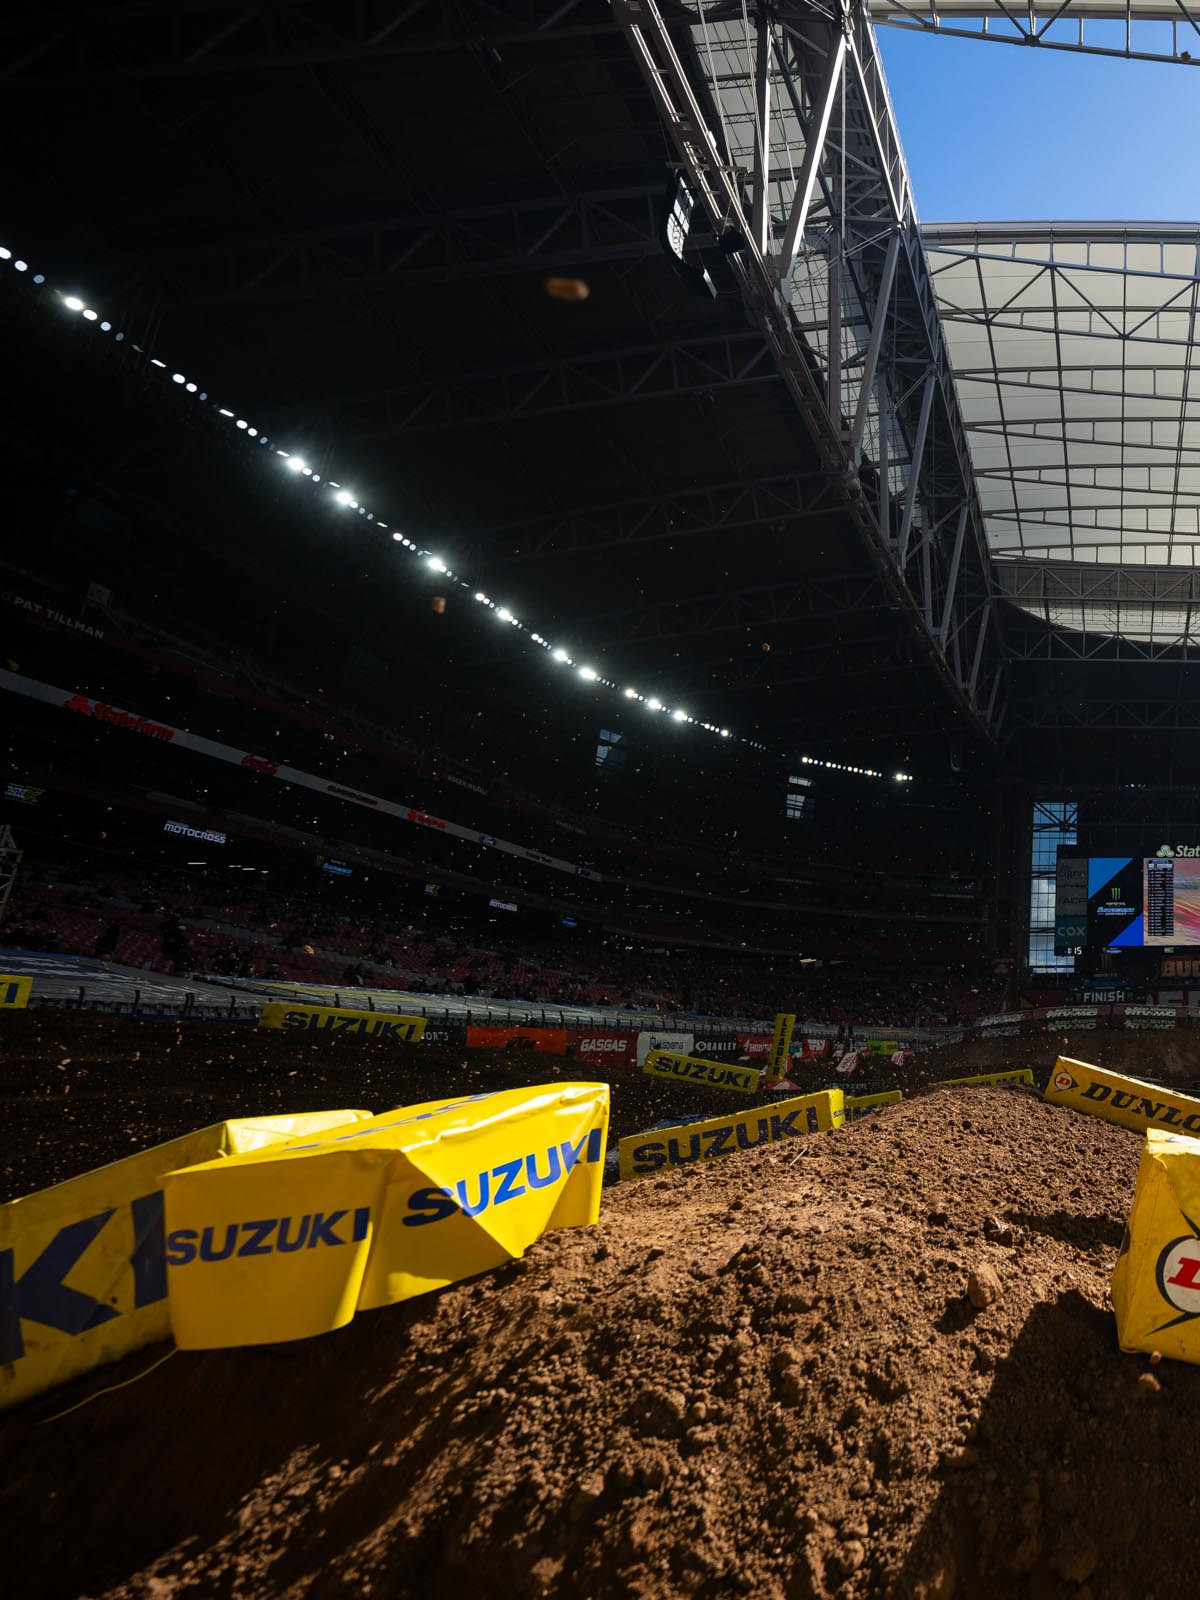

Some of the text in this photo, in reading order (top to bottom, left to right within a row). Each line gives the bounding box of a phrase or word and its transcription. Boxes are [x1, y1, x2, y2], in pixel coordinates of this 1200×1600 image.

[13, 597, 105, 639] PAT TILLMAN
[163, 823, 226, 844] MOTOCROSS
[1057, 926, 1086, 936] COX
[1083, 991, 1125, 1003] FINISH
[281, 1011, 416, 1041] SUZUKI
[580, 1039, 628, 1053] GASGAS
[773, 1017, 787, 1075] LEADER
[652, 1056, 751, 1088] SUZUKI
[632, 1106, 819, 1174] SUZUKI
[165, 1207, 371, 1266] SUZUKI
